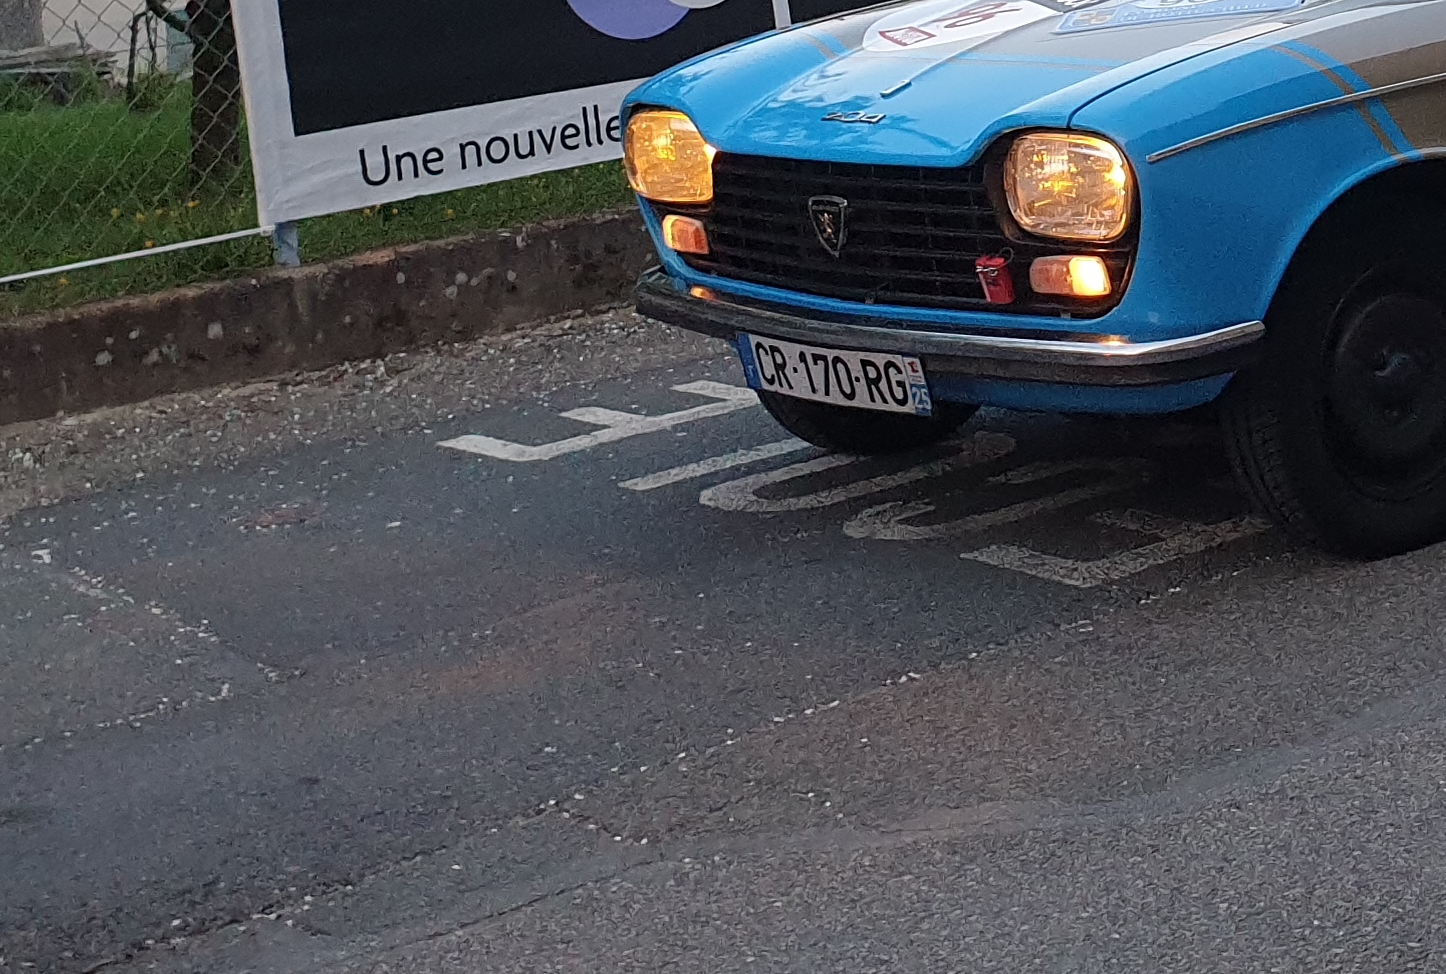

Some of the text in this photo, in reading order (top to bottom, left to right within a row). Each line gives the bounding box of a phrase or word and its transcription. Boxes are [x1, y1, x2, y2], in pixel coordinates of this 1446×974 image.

[932, 2, 1022, 28] 96
[358, 105, 623, 186] Une nouvelle
[911, 386, 932, 410] 25
